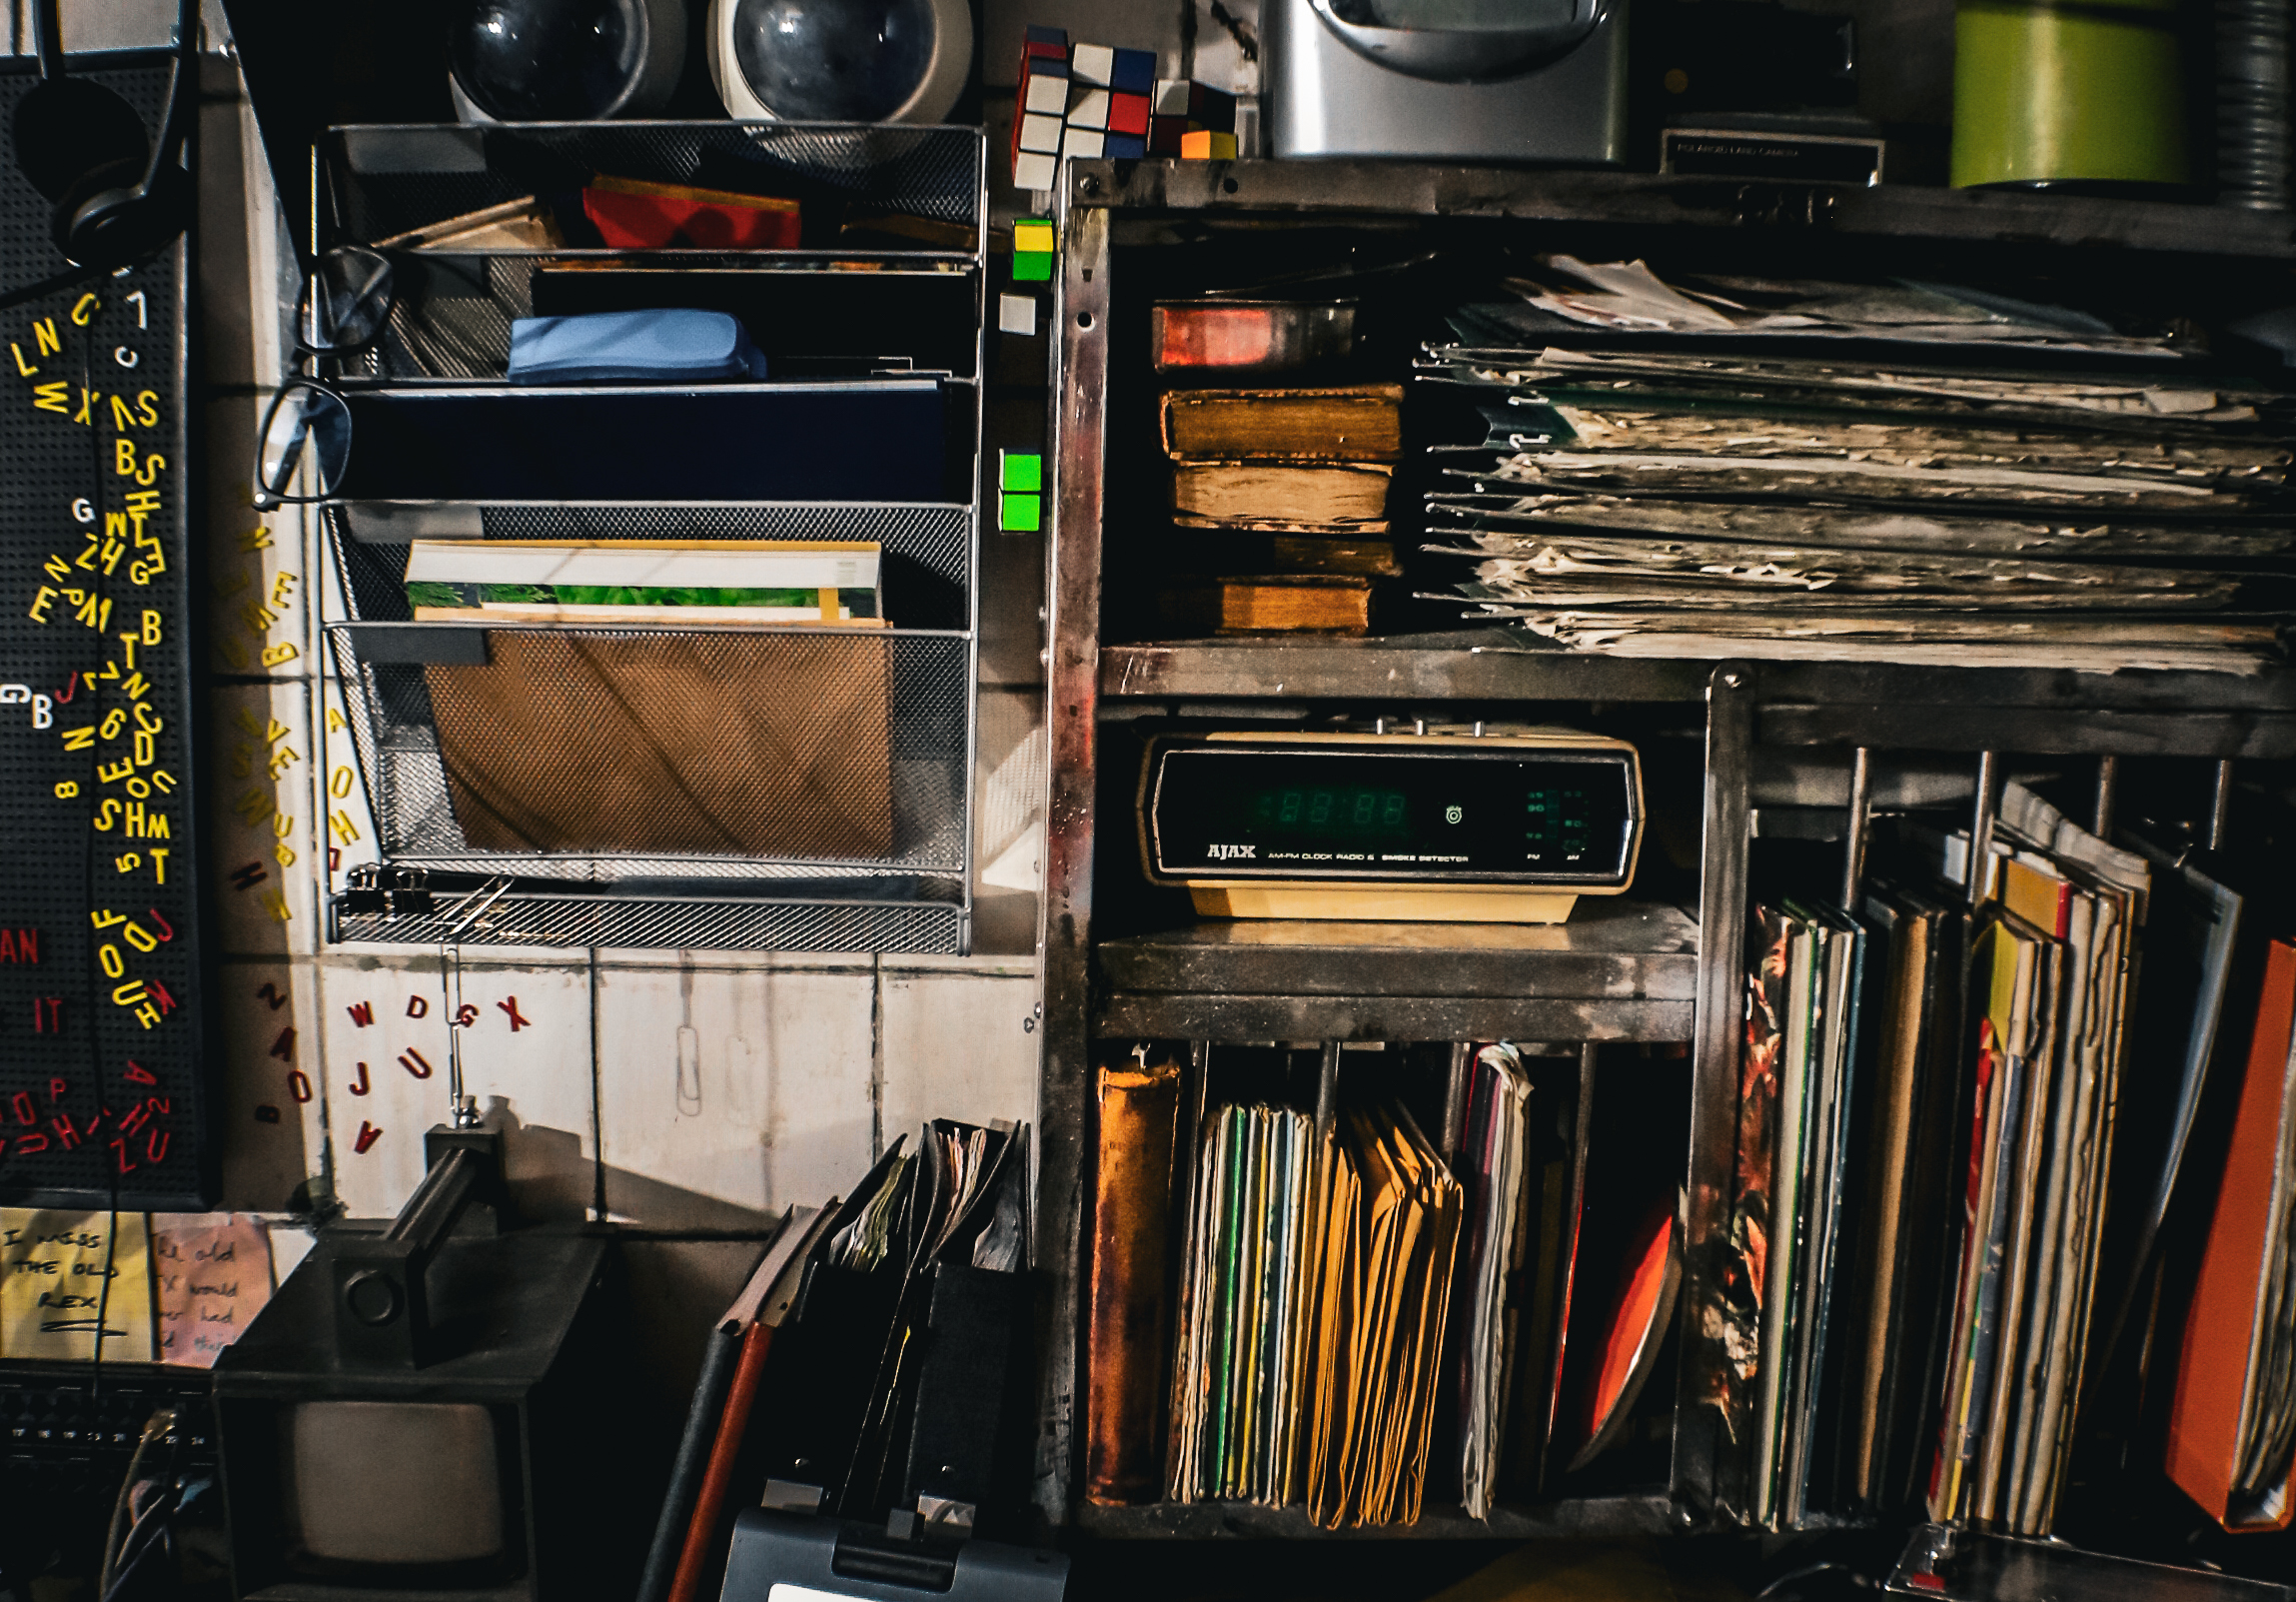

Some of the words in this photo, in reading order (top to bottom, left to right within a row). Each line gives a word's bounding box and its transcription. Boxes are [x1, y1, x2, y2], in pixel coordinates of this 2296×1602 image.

[11, 343, 39, 378] L
[138, 390, 160, 428] S
[116, 439, 136, 476] B
[135, 453, 167, 486] S
[72, 498, 96, 524] G
[130, 560, 150, 586] G
[29, 585, 59, 625] E
[142, 610, 162, 647] B
[120, 633, 140, 670] T
[32, 694, 54, 730] B
[134, 731, 155, 766] D
[93, 798, 123, 831] S
[125, 801, 146, 837] H
[150, 848, 170, 884] T
[1207, 843, 1257, 860] AJAX
[407, 995, 430, 1018] D
[350, 1061, 371, 1096] J
[53, 1113, 82, 1150] H
[3, 1229, 23, 1246] I
[37, 1231, 101, 1248] MISS
[13, 1260, 60, 1274] THE
[38, 1291, 98, 1309] REX
